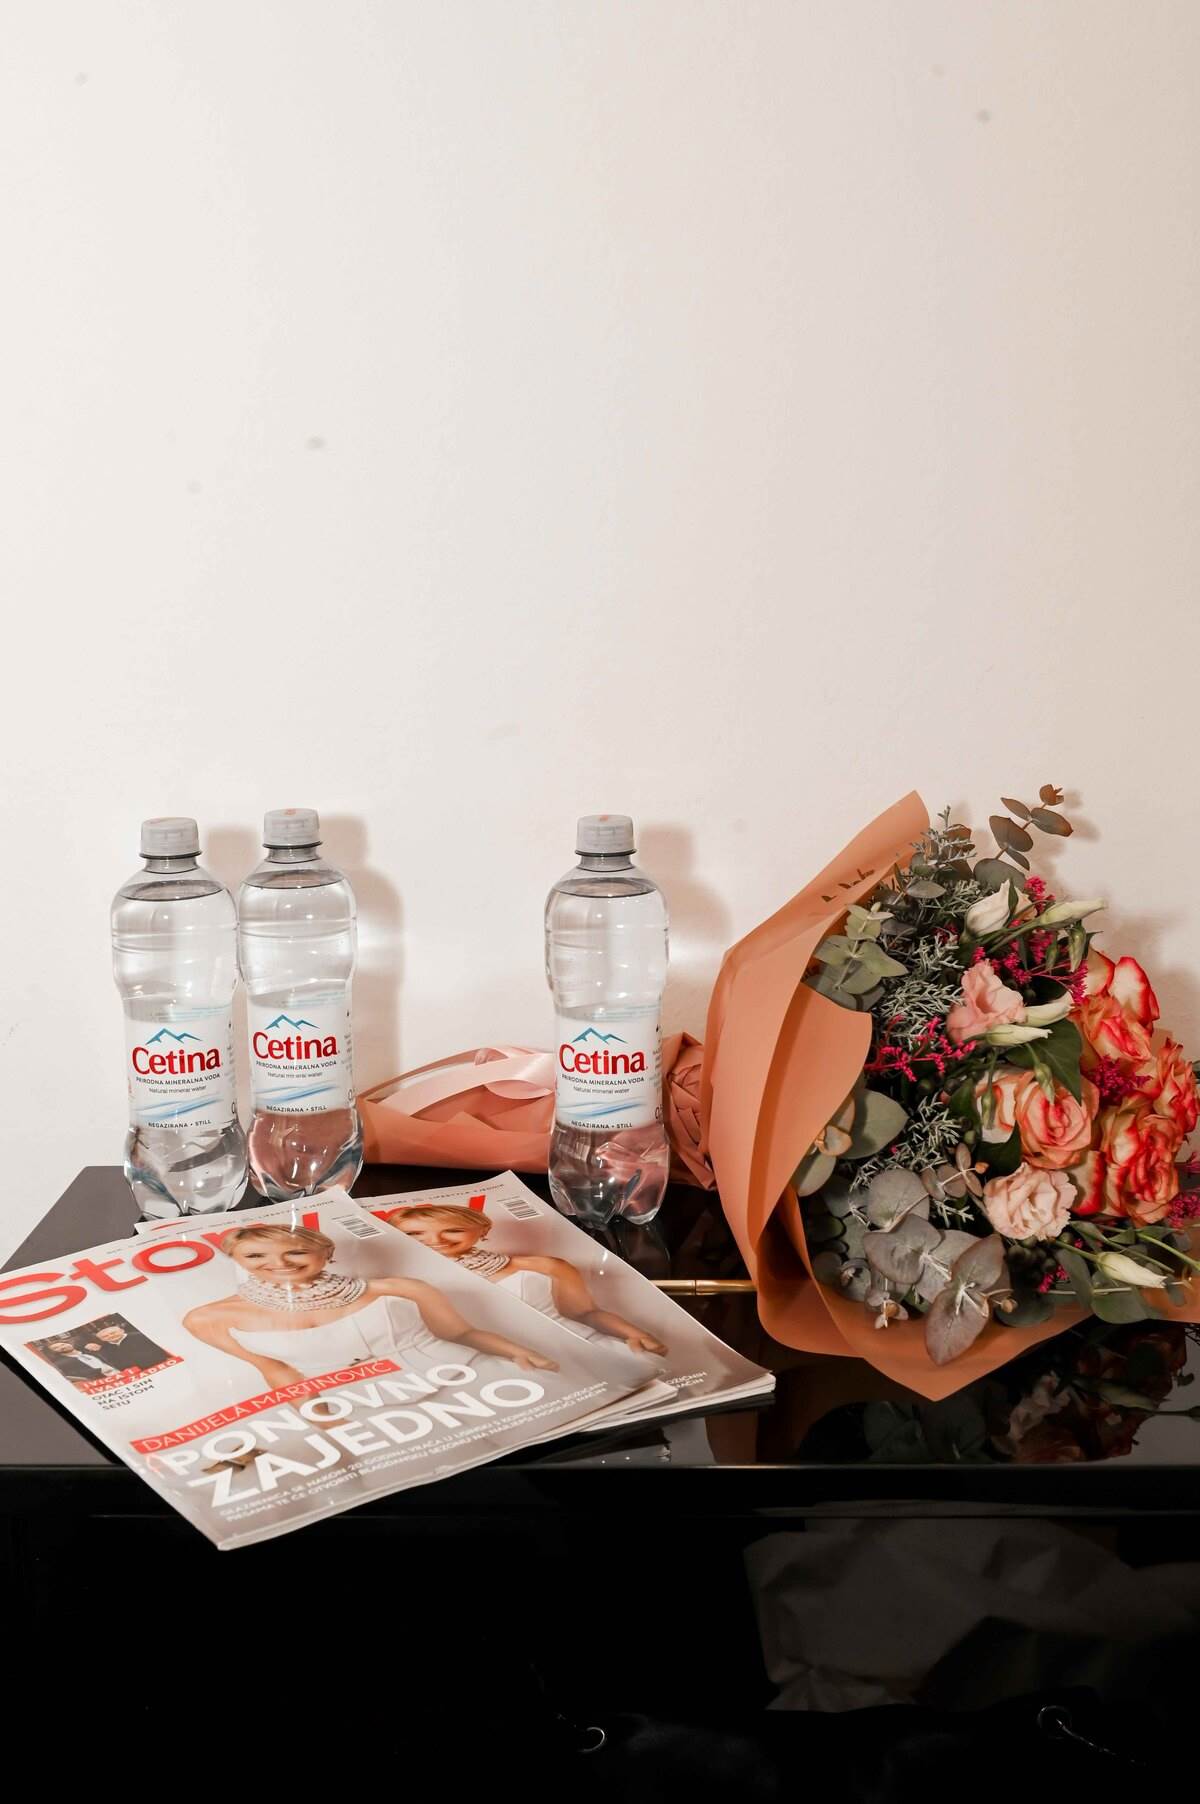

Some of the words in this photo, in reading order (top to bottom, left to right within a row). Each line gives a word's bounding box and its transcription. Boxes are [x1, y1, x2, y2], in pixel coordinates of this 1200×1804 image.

[253, 1032, 337, 1060] Cetina
[132, 1046, 221, 1075] Cetina
[256, 1060, 281, 1070] PRIRODNA
[322, 1060, 337, 1068] VODA
[560, 1044, 645, 1074] Cetina
[136, 1076, 164, 1085] PRIRODNA
[205, 1073, 220, 1081] VODA
[561, 1074, 588, 1084] PRIRODNA
[628, 1076, 644, 1084] VODA
[571, 1120, 609, 1128] NEGAZIRANA
[0, 1211, 320, 1325] Stor
[83, 1373, 125, 1389] IVICA
[89, 1381, 126, 1395] IVAN
[129, 1359, 177, 1382] ZADRO
[92, 1389, 123, 1401] OTAC
[132, 1378, 153, 1389] SIN
[98, 1396, 118, 1406] NA
[118, 1384, 155, 1398] ISTOM
[102, 1400, 131, 1411] SETU
[141, 1406, 250, 1451] DANIJELA
[252, 1360, 392, 1409] MARTINOVIĆ
[158, 1363, 478, 1476] PONOVNO
[186, 1378, 545, 1508] ZAJEDNO
